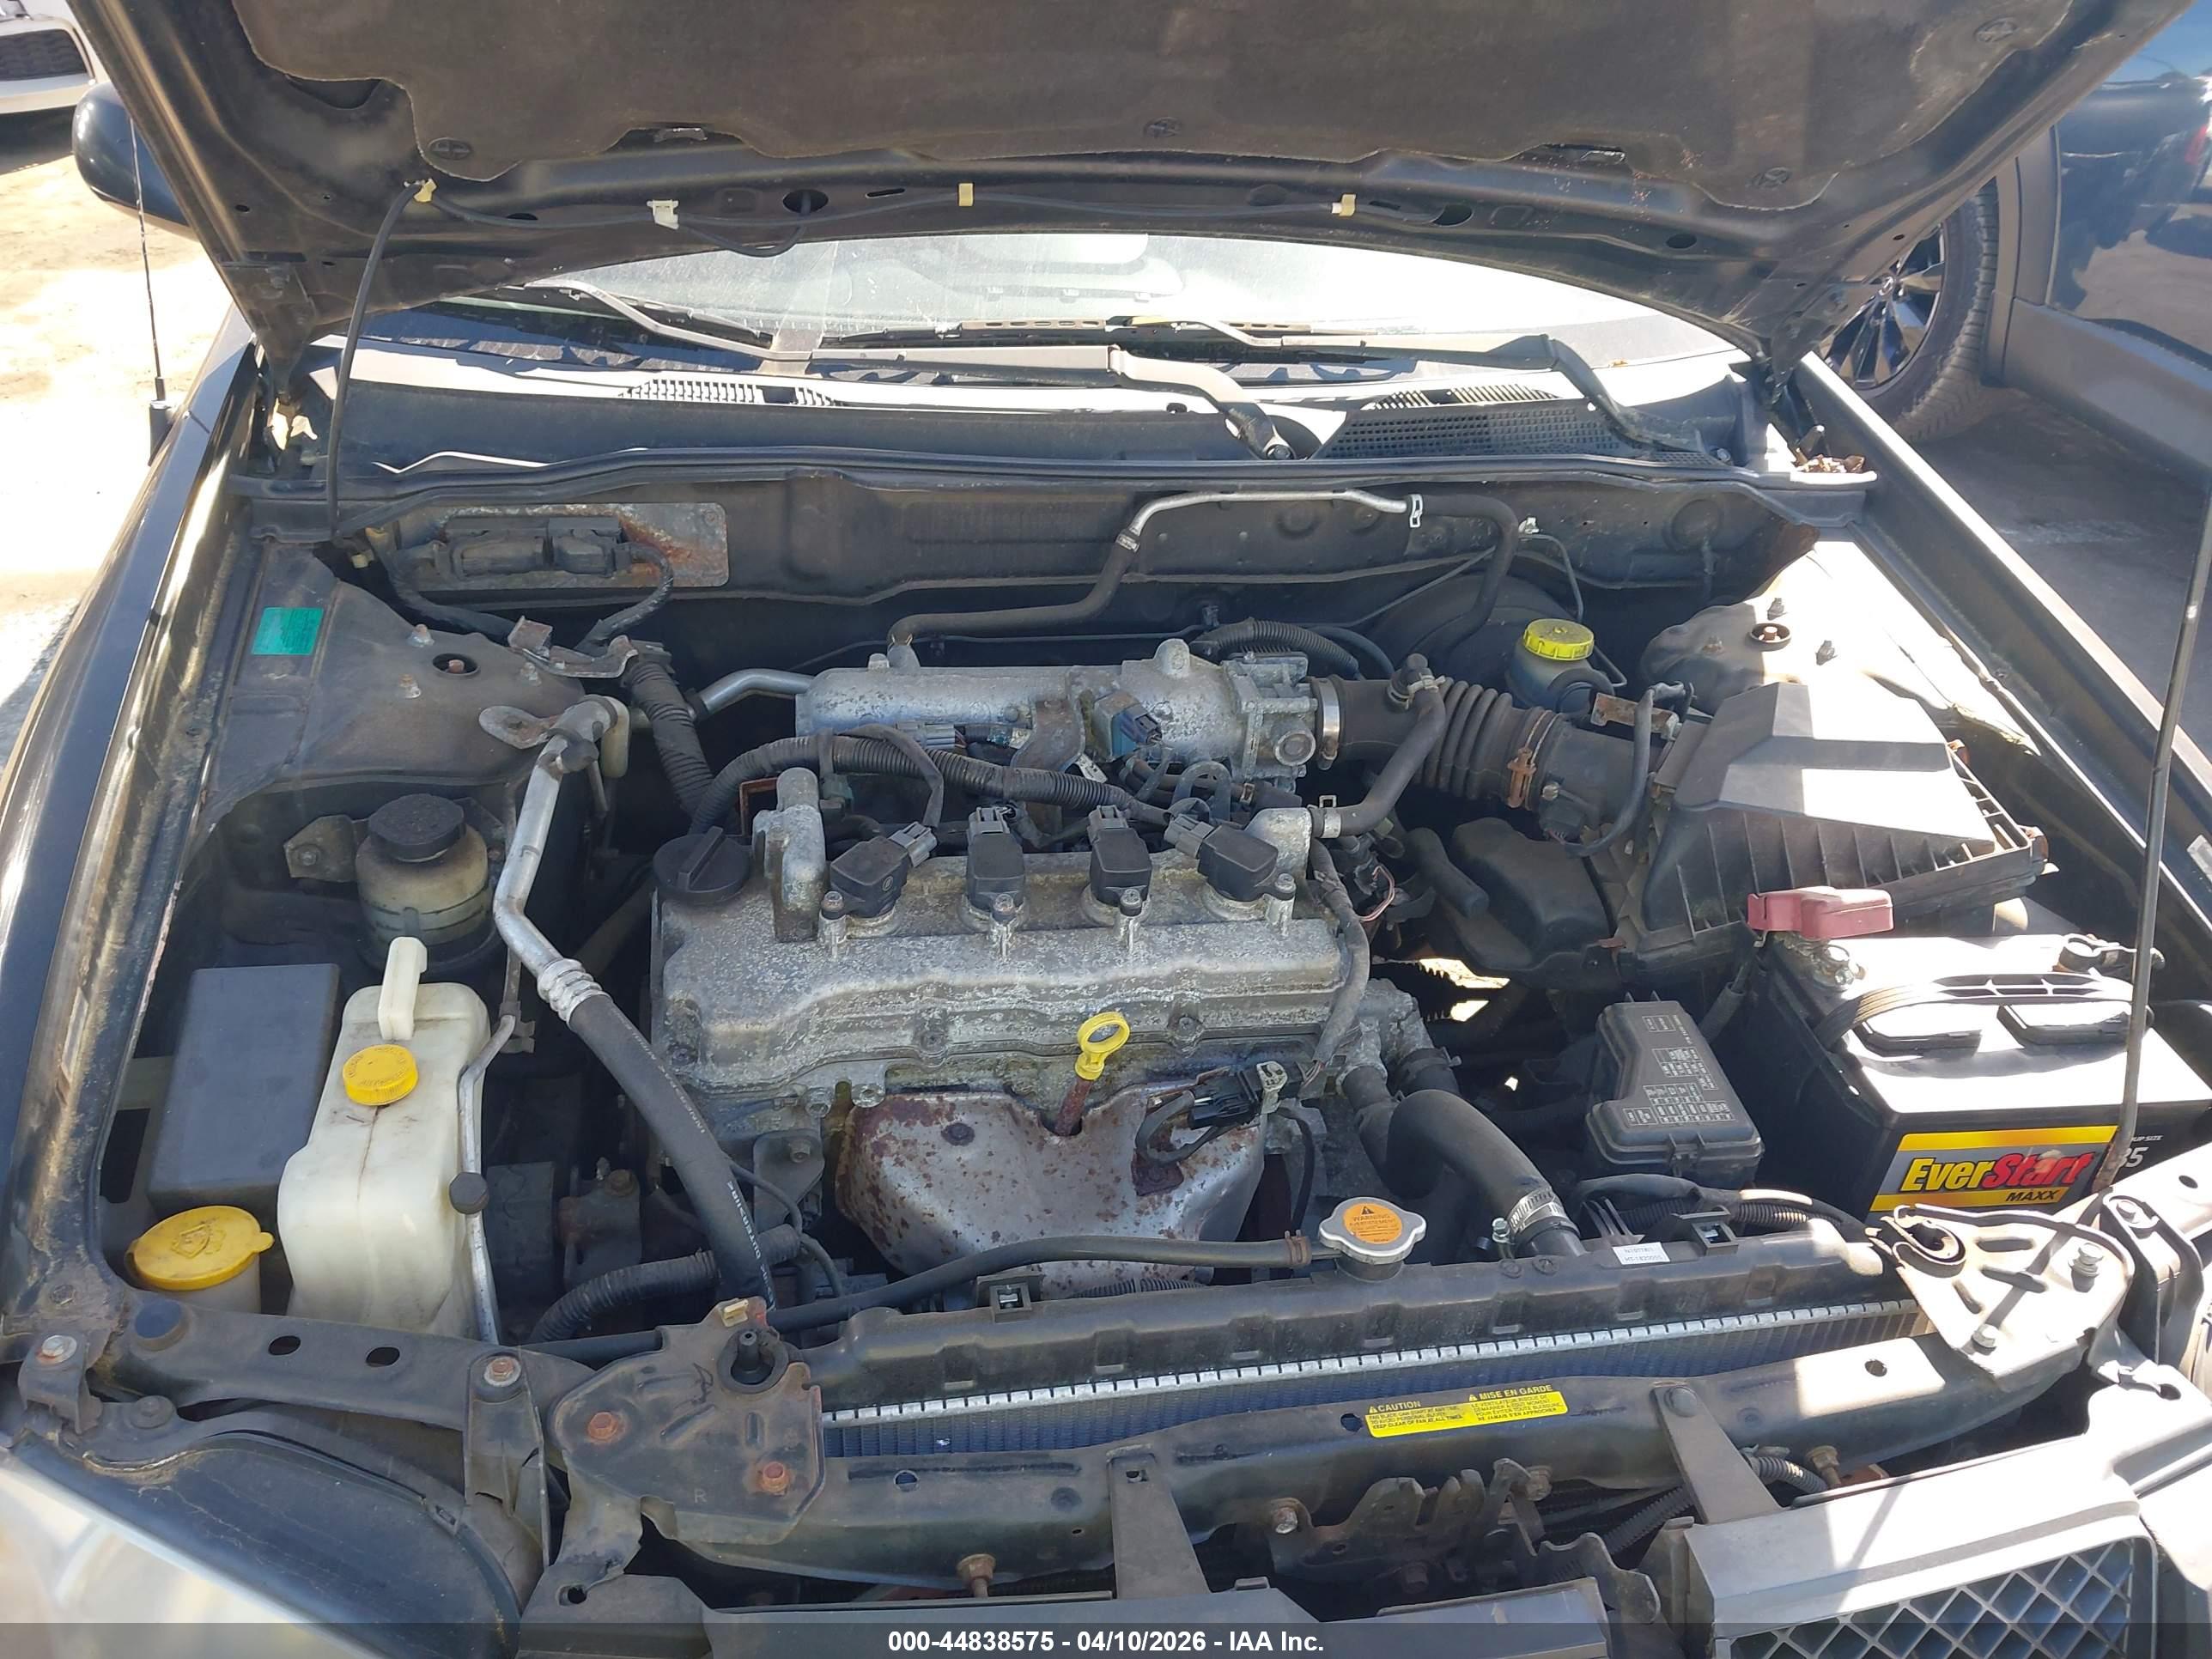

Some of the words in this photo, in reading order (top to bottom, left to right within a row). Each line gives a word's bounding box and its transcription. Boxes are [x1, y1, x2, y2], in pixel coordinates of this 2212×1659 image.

[1899, 1152, 2094, 1191] EverStart
[2005, 1190, 2060, 1202] MAXX
[1479, 1391, 1503, 1401] MISE
[1504, 1389, 1517, 1397] EN
[1519, 1385, 1553, 1395] GARDE
[1377, 1401, 1421, 1413] CAUTION
